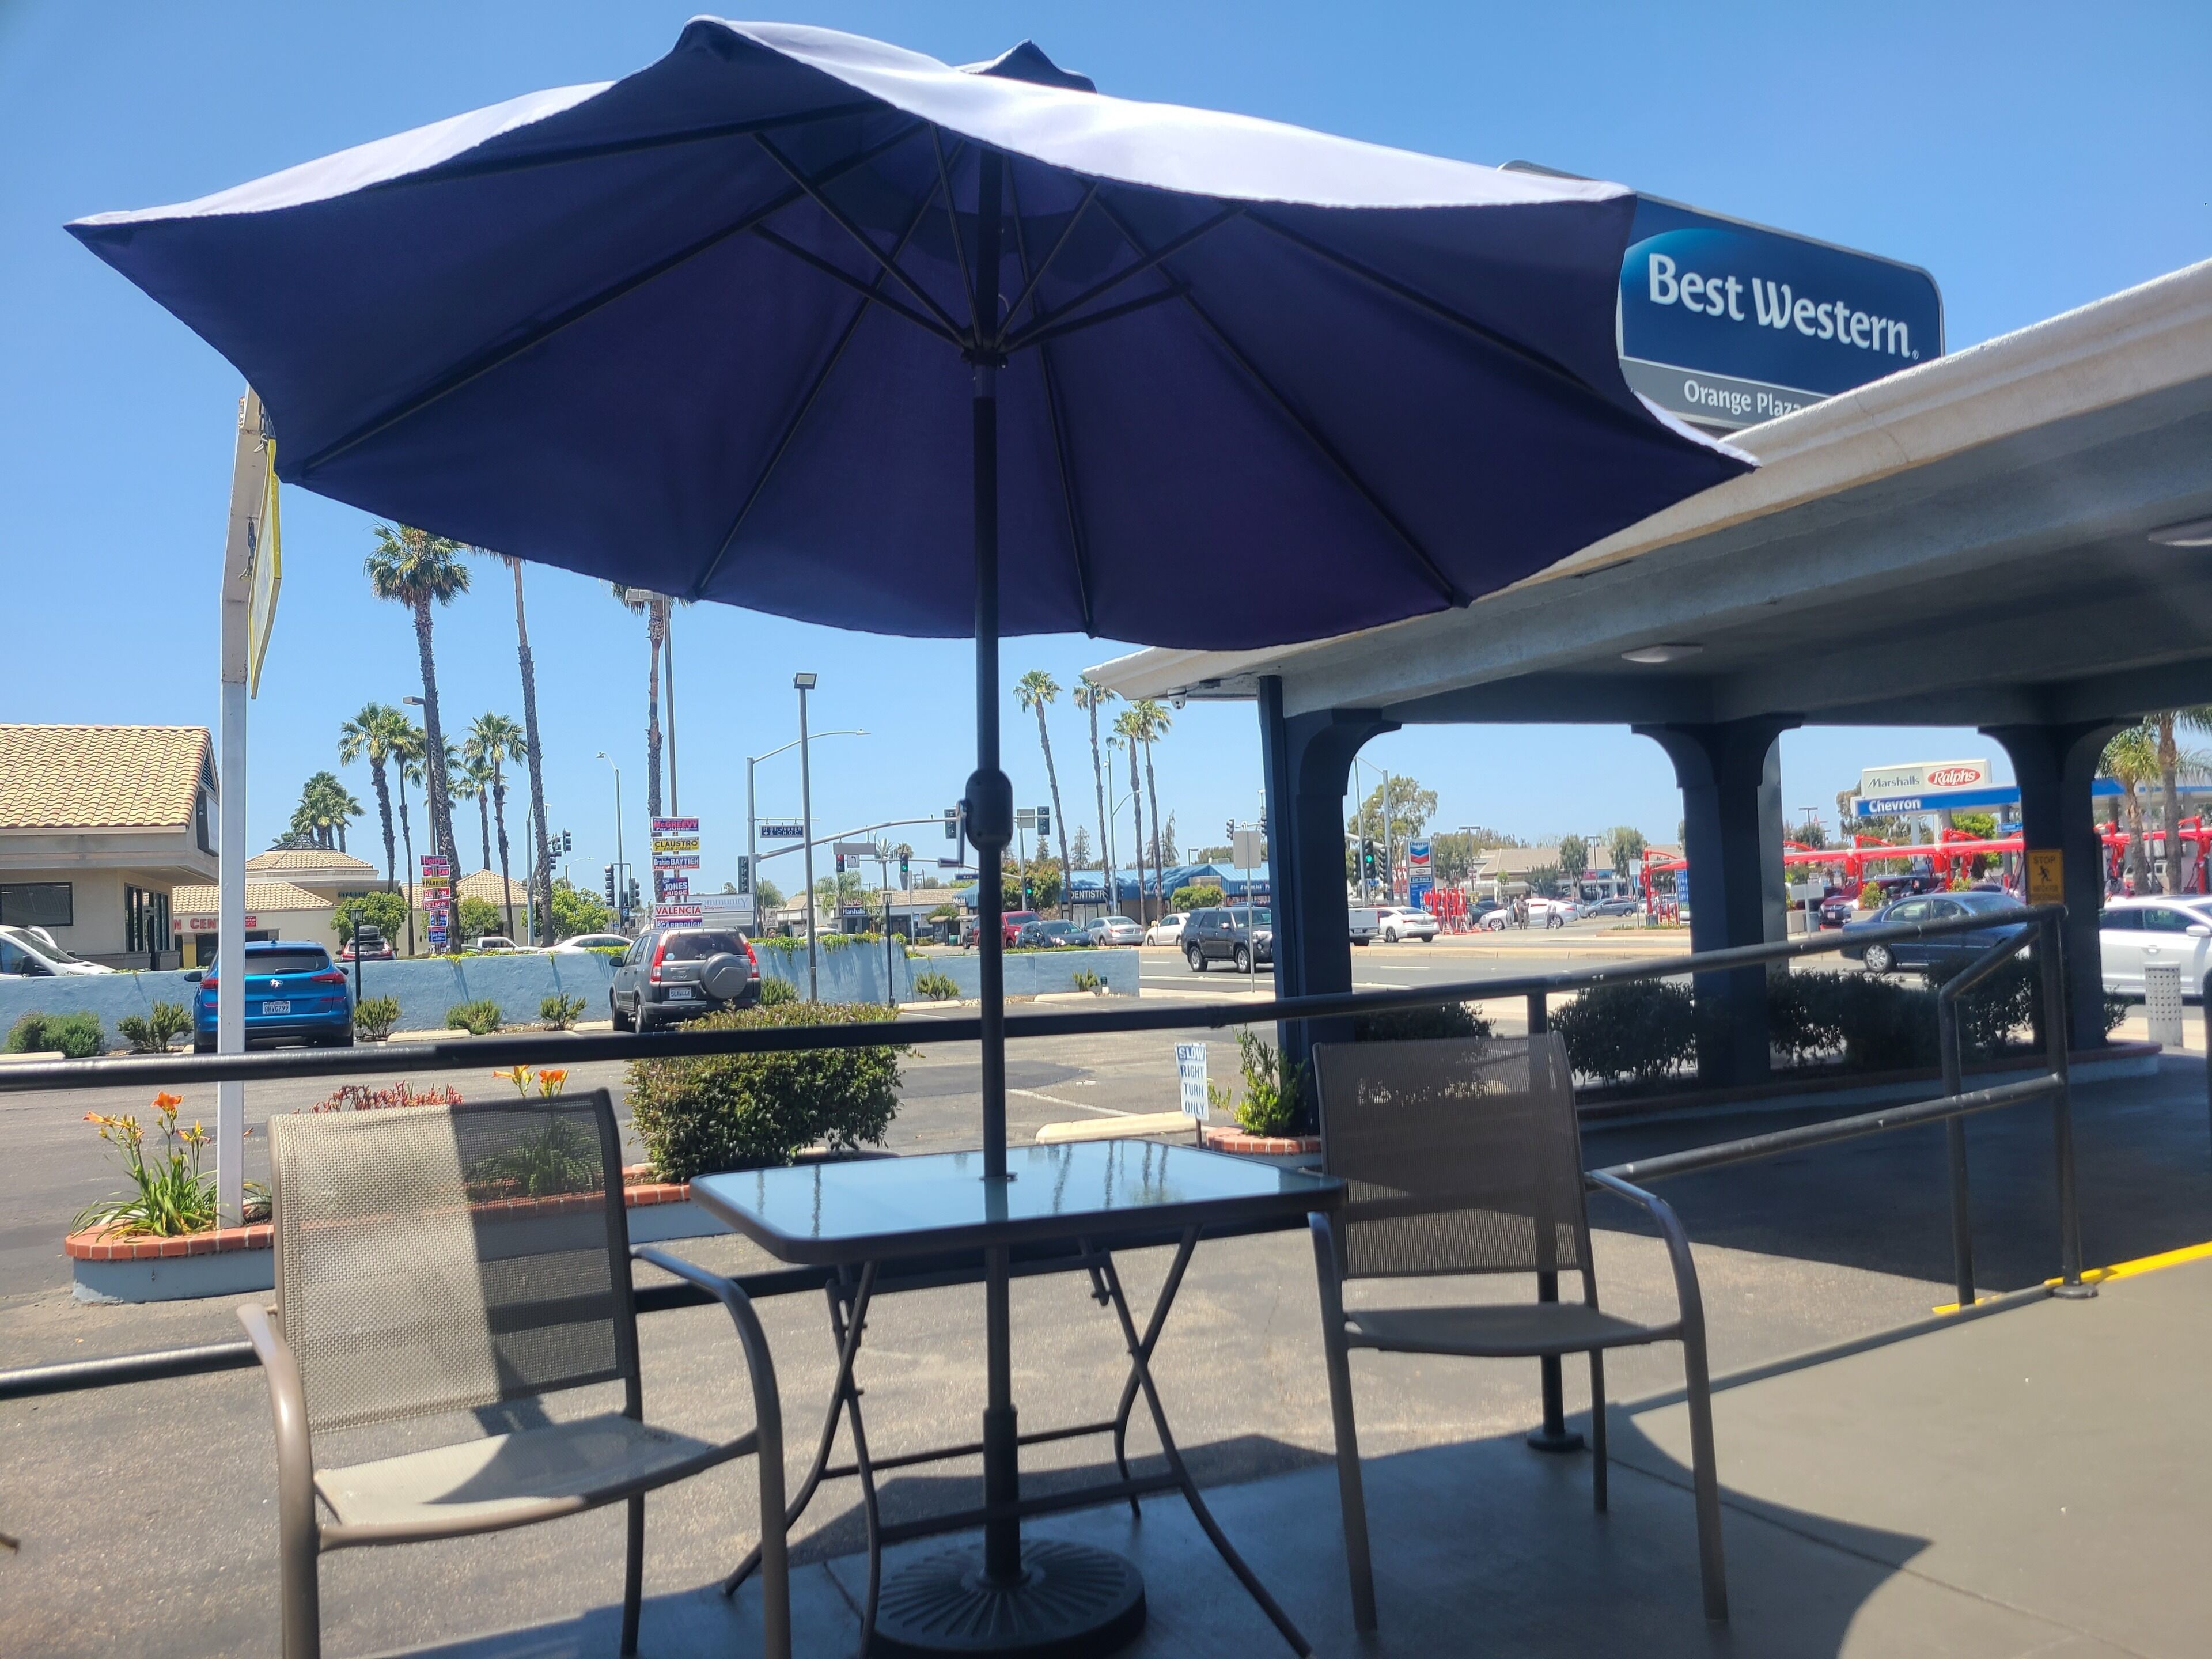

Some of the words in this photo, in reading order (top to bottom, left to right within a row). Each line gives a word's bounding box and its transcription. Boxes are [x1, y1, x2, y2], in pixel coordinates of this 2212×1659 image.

[1649, 253, 1744, 321] Best
[1752, 277, 1910, 358] Western
[1684, 379, 1751, 415] Orange
[1868, 775, 1920, 789] Marshalls
[1933, 769, 1976, 785] Ralphs
[1869, 799, 1921, 813] Chevron
[654, 820, 698, 828] McGREEVY
[2033, 855, 2055, 864] STOP
[664, 882, 687, 891] JONES
[1070, 889, 1105, 899] DENTISTR
[694, 897, 749, 908] ommunity
[1179, 1047, 1205, 1060] SLOW
[1181, 1065, 1204, 1078] RIGHT
[1184, 1083, 1204, 1097] TURN
[1185, 1101, 1205, 1116] ONLY
